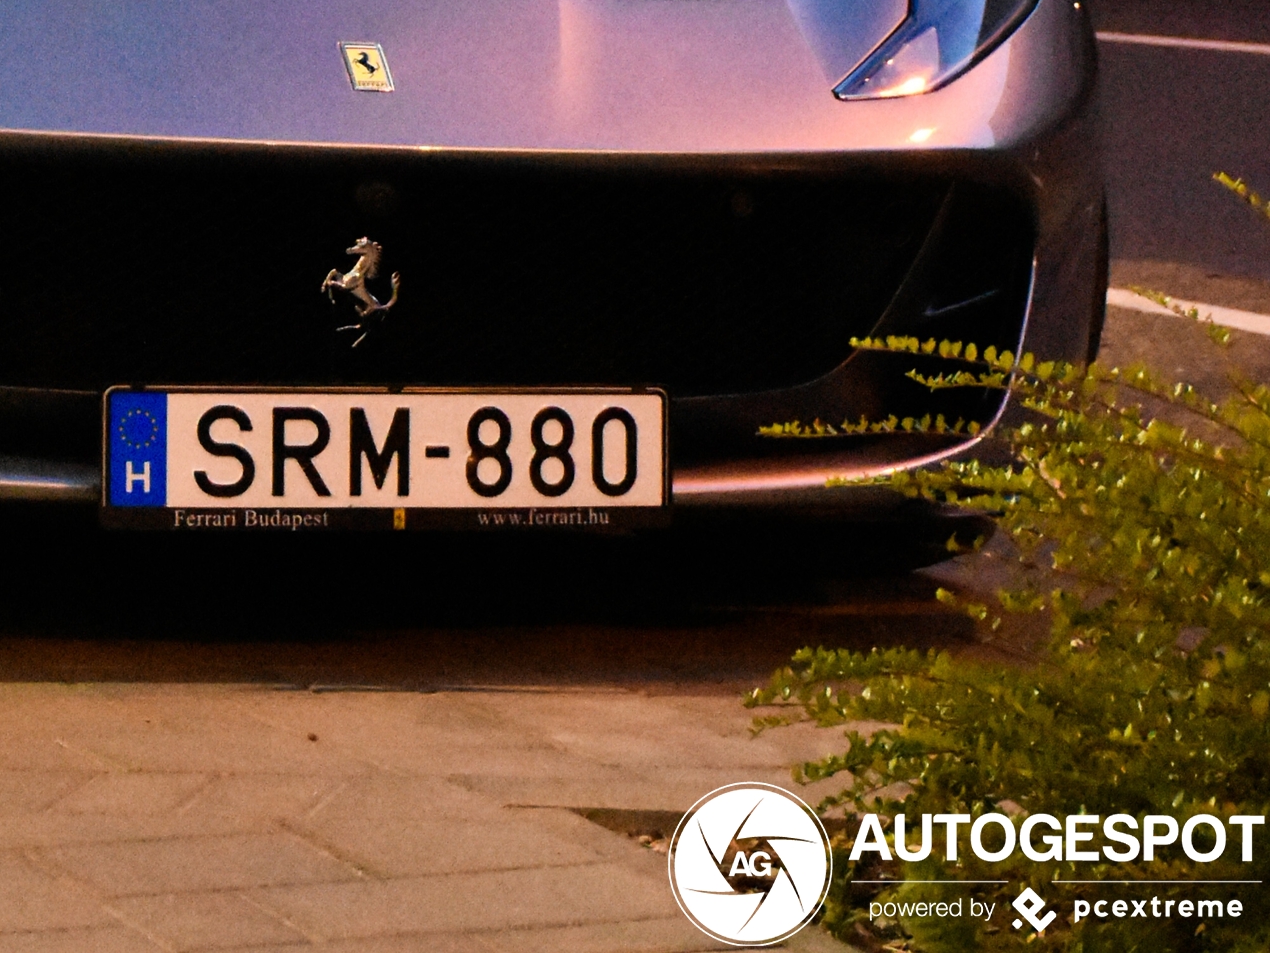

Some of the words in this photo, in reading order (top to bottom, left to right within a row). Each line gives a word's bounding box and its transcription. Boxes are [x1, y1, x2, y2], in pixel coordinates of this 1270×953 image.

[193, 404, 638, 499] SRM-880
[125, 461, 151, 493] H
[173, 508, 237, 527] Ferrari
[244, 508, 329, 531] Budapest
[477, 507, 609, 525] www.ferrari.hu
